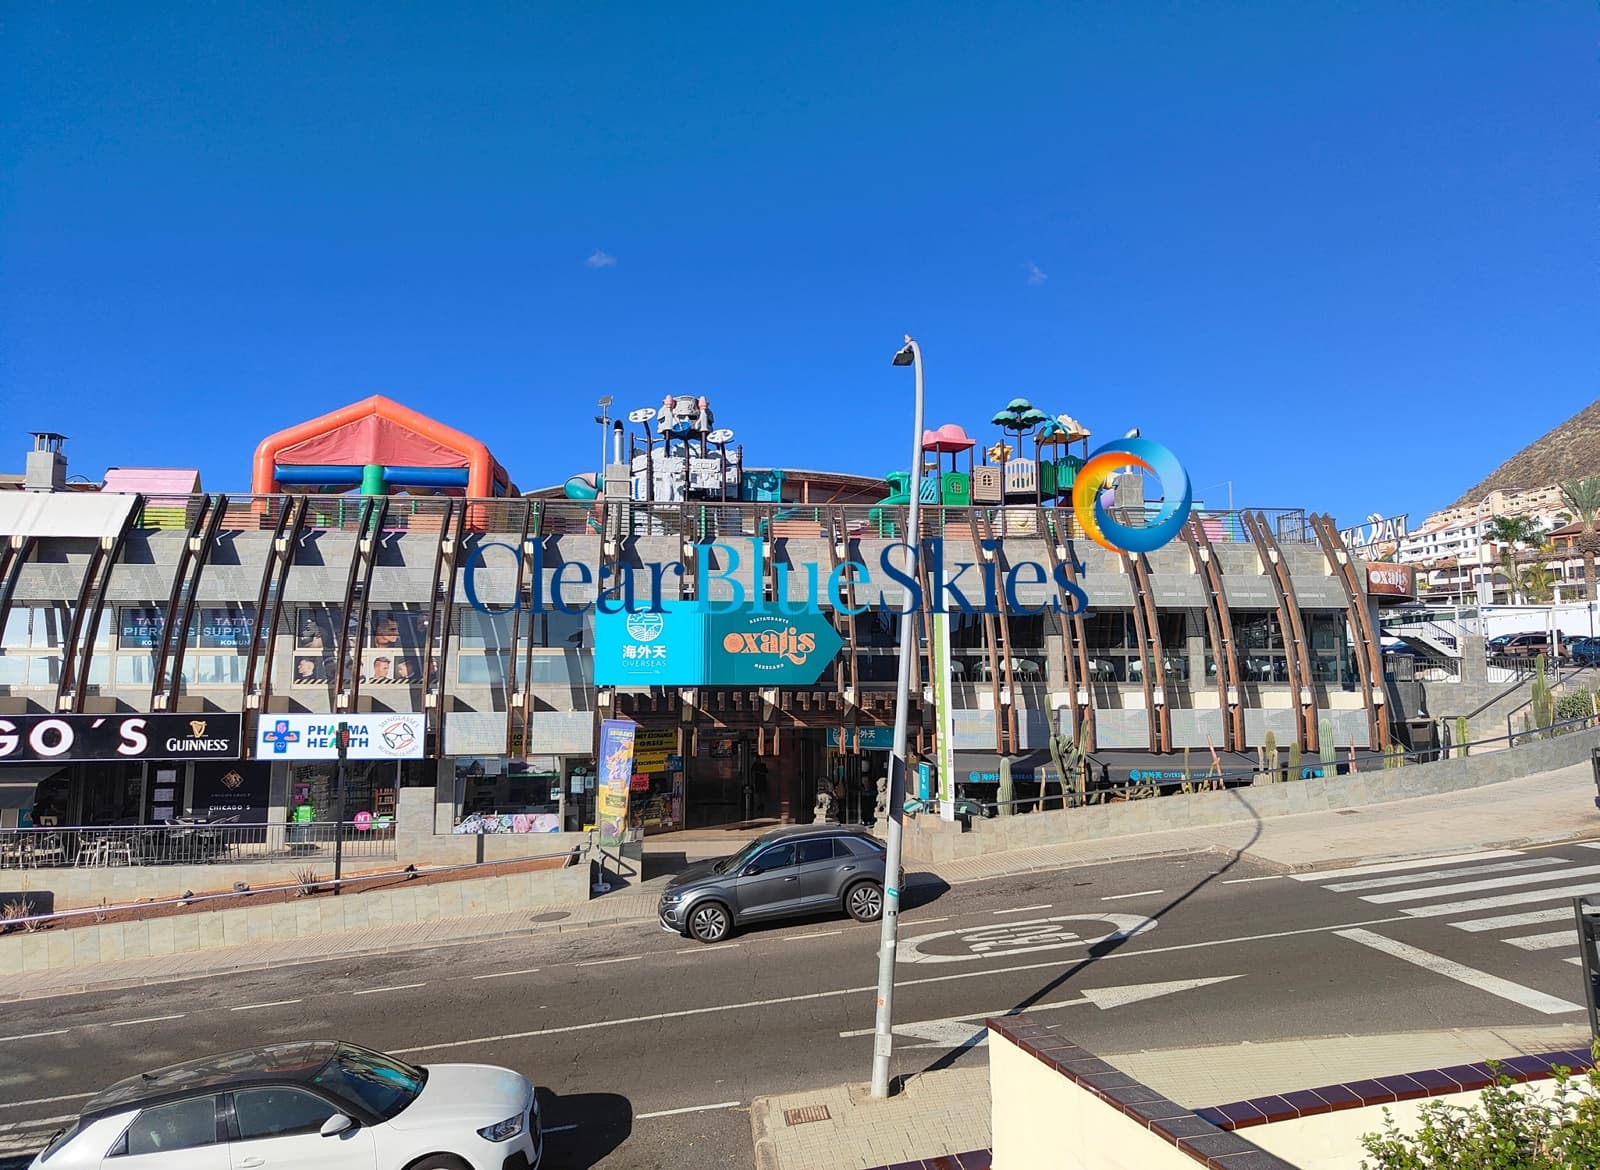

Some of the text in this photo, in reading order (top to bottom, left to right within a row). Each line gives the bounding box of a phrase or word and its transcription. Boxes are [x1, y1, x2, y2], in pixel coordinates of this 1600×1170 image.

[136, 618, 182, 626] TATTO
[215, 618, 256, 626] TATTO
[123, 627, 196, 637] PIERCNG
[203, 627, 270, 637] SUPPLES
[723, 627, 816, 665] oxalis
[622, 645, 667, 659] 海外天
[622, 660, 666, 668] OVERSEAS
[308, 725, 368, 735] PHAMA
[166, 738, 229, 752] GUINNESS
[307, 738, 368, 748] HEATH
